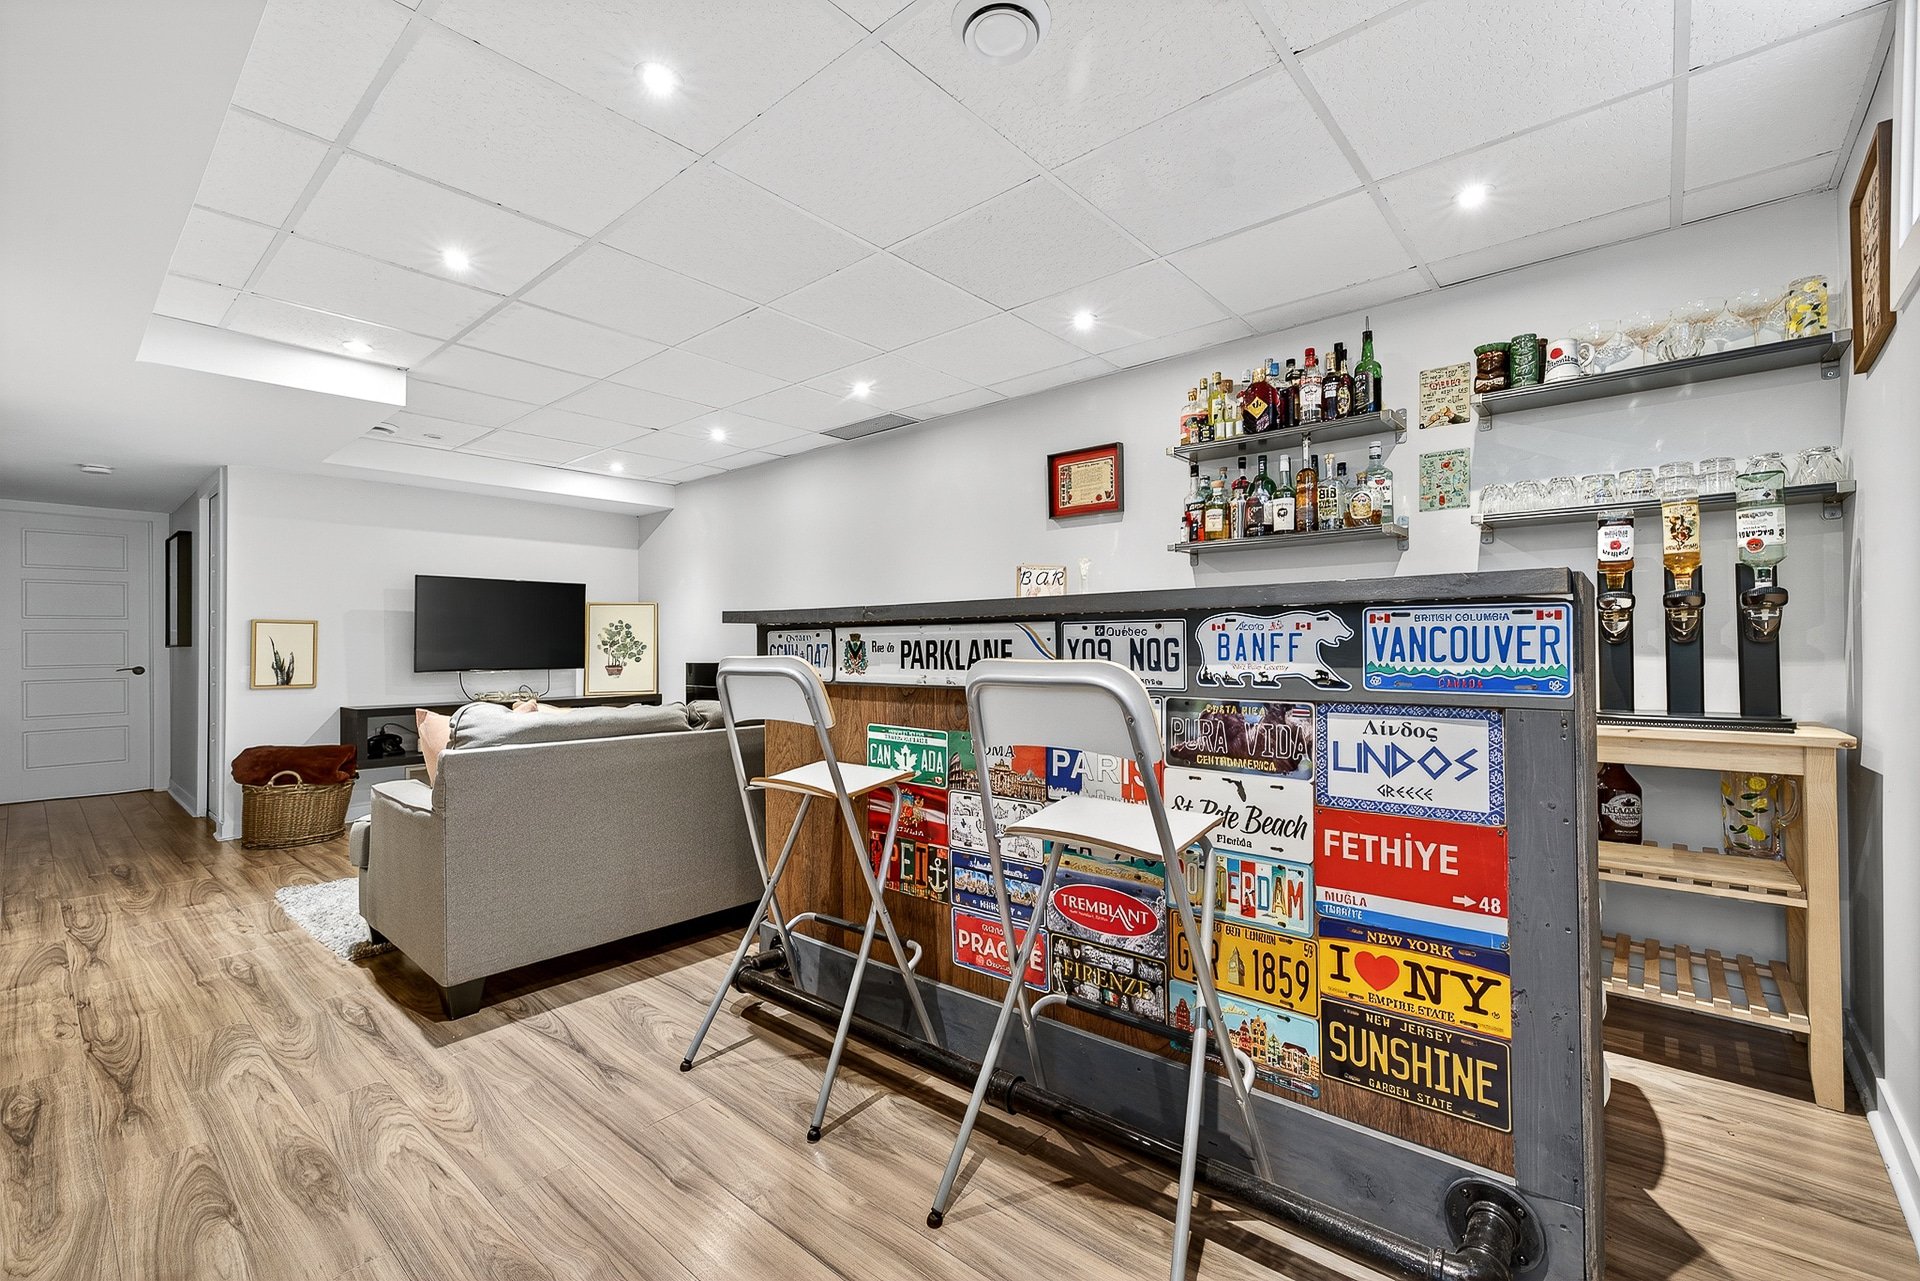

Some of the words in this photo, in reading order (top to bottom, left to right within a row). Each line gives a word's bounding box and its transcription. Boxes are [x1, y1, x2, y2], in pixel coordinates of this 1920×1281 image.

[1106, 626, 1148, 637] Québec
[1414, 613, 1453, 622] BRITISH
[1454, 612, 1510, 622] COLUMBIA
[900, 638, 1013, 671] PARKLANE
[1129, 637, 1180, 673] NQG
[1217, 632, 1303, 663] BANFF
[1371, 625, 1561, 665] VANCOUVER
[1438, 677, 1483, 689] CANADA
[1205, 704, 1237, 715] COSTA
[1241, 705, 1266, 716] RICA
[1171, 717, 1228, 755] PURA
[1244, 721, 1309, 760] VIDA
[1362, 719, 1438, 742] Λίνδος
[870, 743, 891, 766] CAN
[921, 749, 944, 774] ADA
[1052, 749, 1145, 787] PARIS
[1196, 754, 1277, 772] CENTROAMERICA
[1332, 739, 1479, 782] LINDOS
[1376, 783, 1434, 801] GREECE
[1240, 805, 1308, 841] Beach
[1216, 834, 1253, 848] Florida
[1324, 829, 1459, 876] FETHİYE
[1060, 893, 1149, 932] TREMBLANT
[1478, 896, 1501, 914] 48
[958, 929, 1044, 972] PRAGE
[1225, 924, 1241, 938] BEN
[1244, 930, 1277, 946] LONDON
[1366, 930, 1403, 947] NEW
[1406, 938, 1455, 959] YORK
[1063, 959, 1150, 1000] FIRENZE
[1252, 949, 1310, 1002] 1859
[1329, 944, 1351, 983] I
[1403, 960, 1502, 1016] NY
[1368, 992, 1415, 1013] EMPIRE
[1418, 1005, 1456, 1024] STATE
[1366, 1012, 1391, 1028] NEW
[1400, 1022, 1453, 1044] JERSEY
[1329, 1020, 1499, 1109] SUNSHINE
[1368, 1078, 1410, 1098] GARDEN
[1417, 1092, 1453, 1111] STATE
